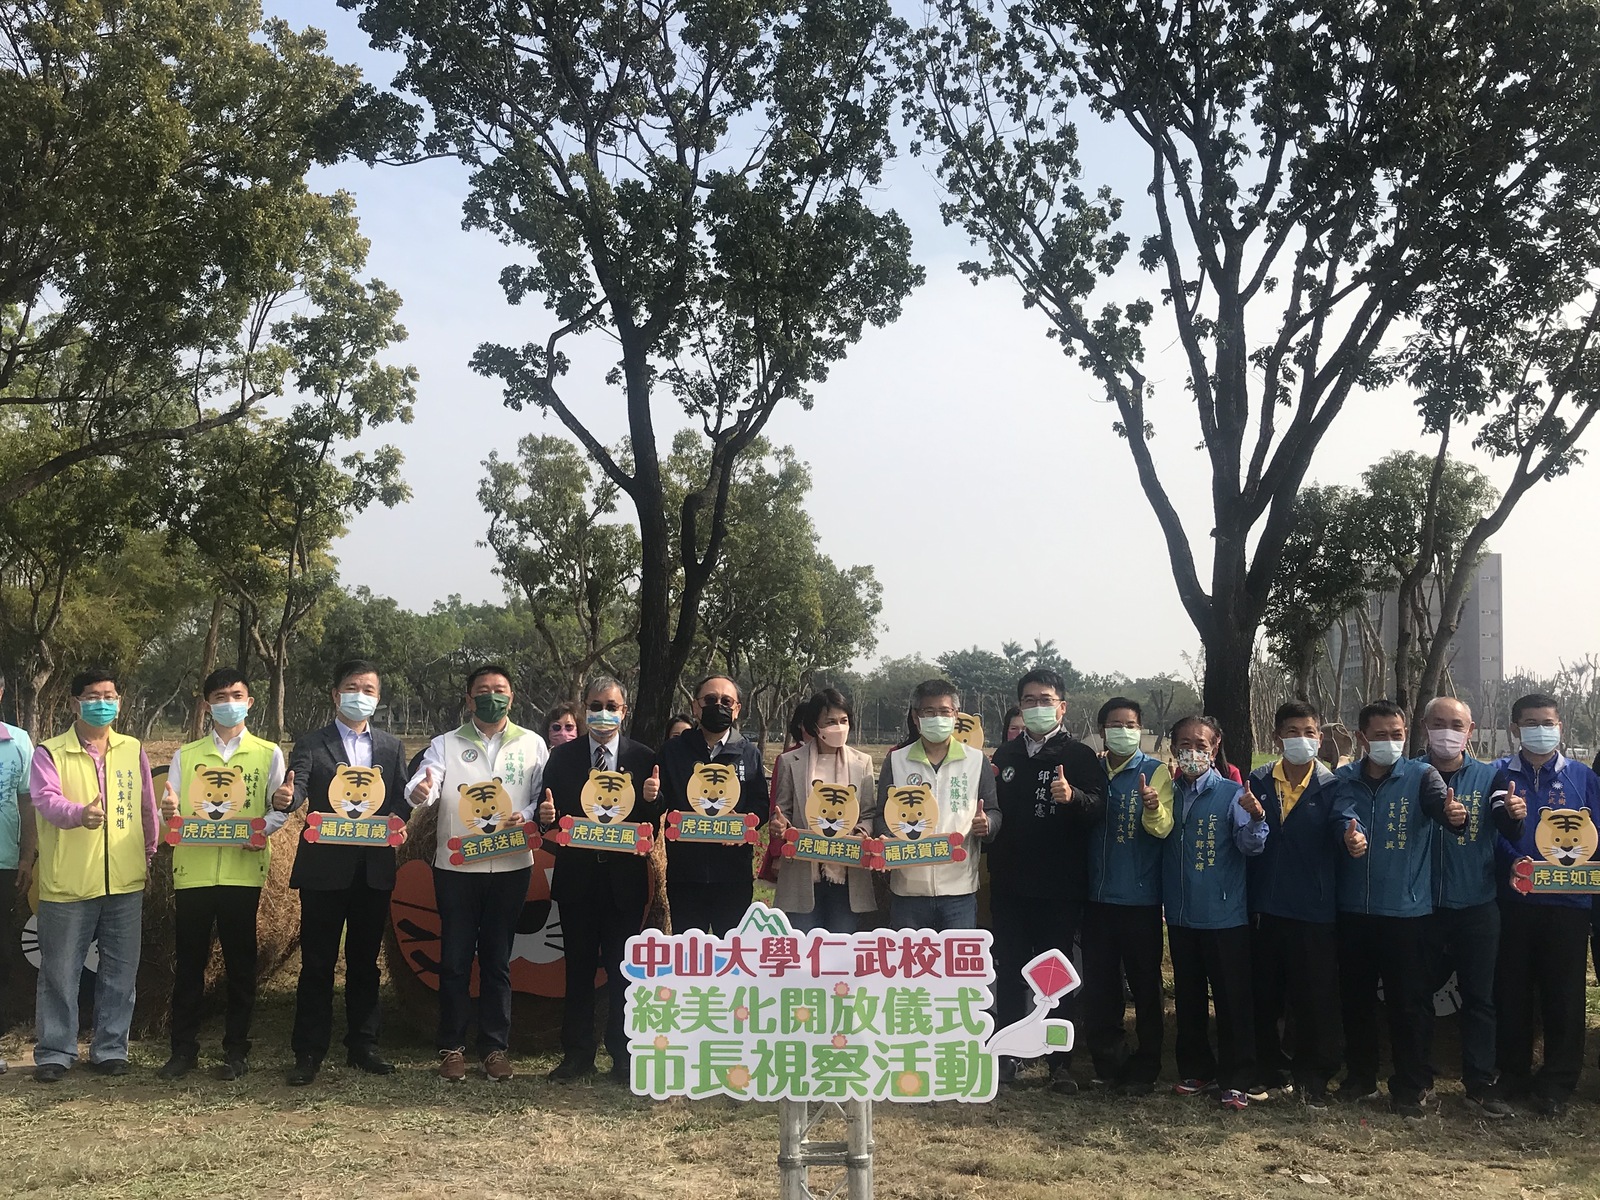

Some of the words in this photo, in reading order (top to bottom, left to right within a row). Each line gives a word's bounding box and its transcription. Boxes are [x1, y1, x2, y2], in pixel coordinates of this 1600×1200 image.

[126, 769, 134, 822] 大社區公所
[949, 776, 961, 813] 張勝富
[1034, 770, 1050, 818] 邱俊憲
[182, 823, 250, 840] 虎虎生風
[320, 821, 387, 839] 福虎賀歲
[572, 824, 636, 845] 虎虎生風
[681, 818, 744, 836] 虎年如意
[1397, 796, 1409, 850] 仁武區仁福里
[463, 830, 526, 857] 金虎送福
[797, 837, 861, 860] 虎嘯祥瑞
[884, 841, 950, 862] 福虎賀歲
[1206, 813, 1218, 867] 仁武區灣內里
[1533, 869, 1600, 886] 虎年如意
[632, 936, 987, 978] 中山大學仁武校區
[632, 986, 986, 1035] 綠美化開放儀式
[632, 1039, 993, 1097] 市長視察活動
